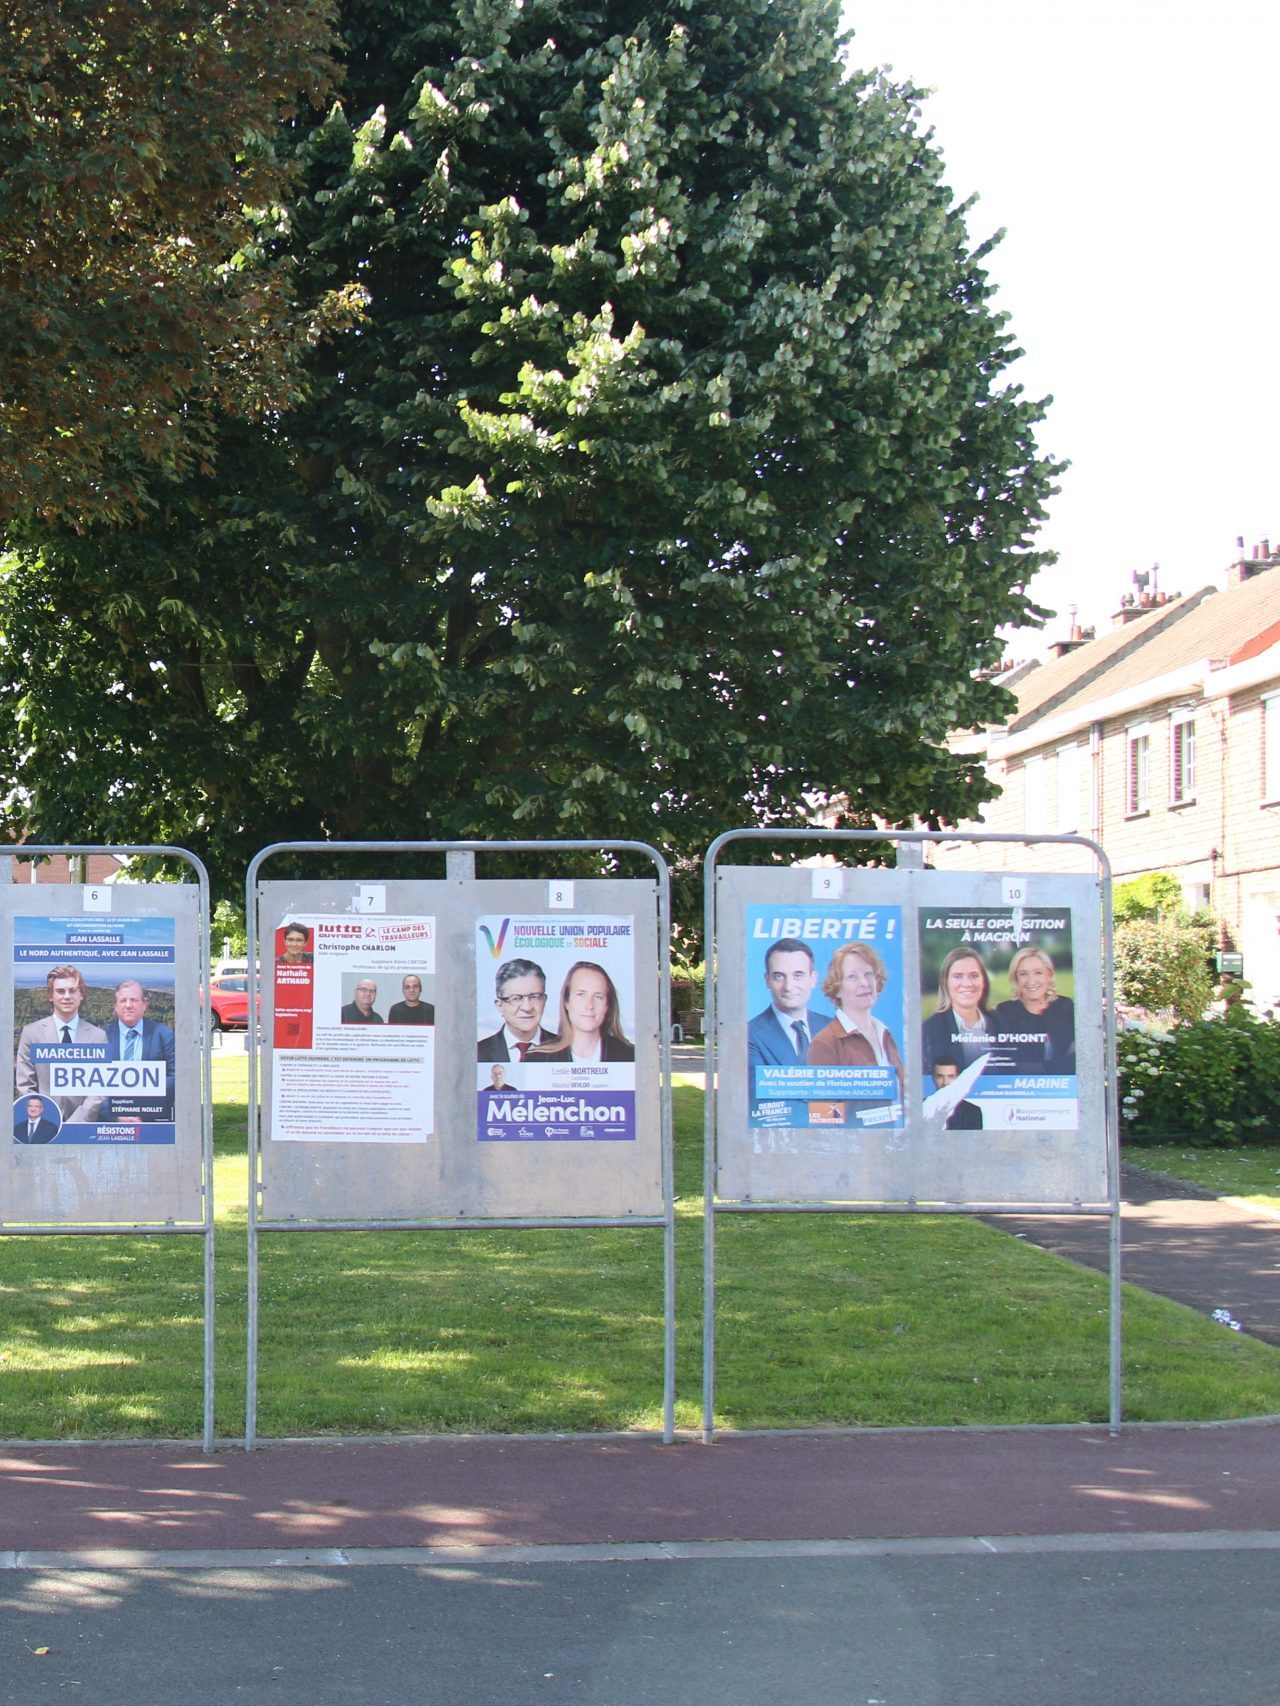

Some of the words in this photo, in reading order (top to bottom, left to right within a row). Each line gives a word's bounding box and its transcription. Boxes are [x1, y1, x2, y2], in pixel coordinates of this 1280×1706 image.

[824, 879, 830, 888] 9
[92, 891, 98, 900] 6
[556, 892, 562, 901] 8
[1009, 890, 1021, 899] 10
[368, 897, 374, 906] 7
[319, 924, 362, 932] lutte
[753, 912, 878, 939] LIBERTÉ
[885, 919, 896, 939] !
[926, 919, 942, 928] LA
[945, 919, 984, 928] SEULE
[987, 919, 1065, 929] OPPSITION
[514, 926, 555, 936] NOUVELLE
[560, 926, 584, 935] UNION
[587, 926, 631, 935] POPULAIRE
[961, 930, 970, 942] À
[381, 932, 429, 941] TRAVAILLEURS
[514, 937, 564, 948] ÉCOLOGIQUE
[574, 938, 607, 948] SOCIALE
[319, 944, 360, 952] Christophe
[951, 1033, 996, 1043] Mélanie
[36, 1049, 105, 1059] MARCELLIN
[54, 1067, 160, 1088] BRAZON
[764, 1067, 814, 1078] VALÉRIE
[817, 1069, 888, 1078] DUMORTIER
[1014, 1078, 1069, 1089] MARINE
[537, 1095, 575, 1105] Jean-Luc
[759, 1101, 785, 1109] DEBOUT
[486, 1099, 625, 1122] Mélenchon
[97, 1126, 135, 1135] RÉSISTONS
